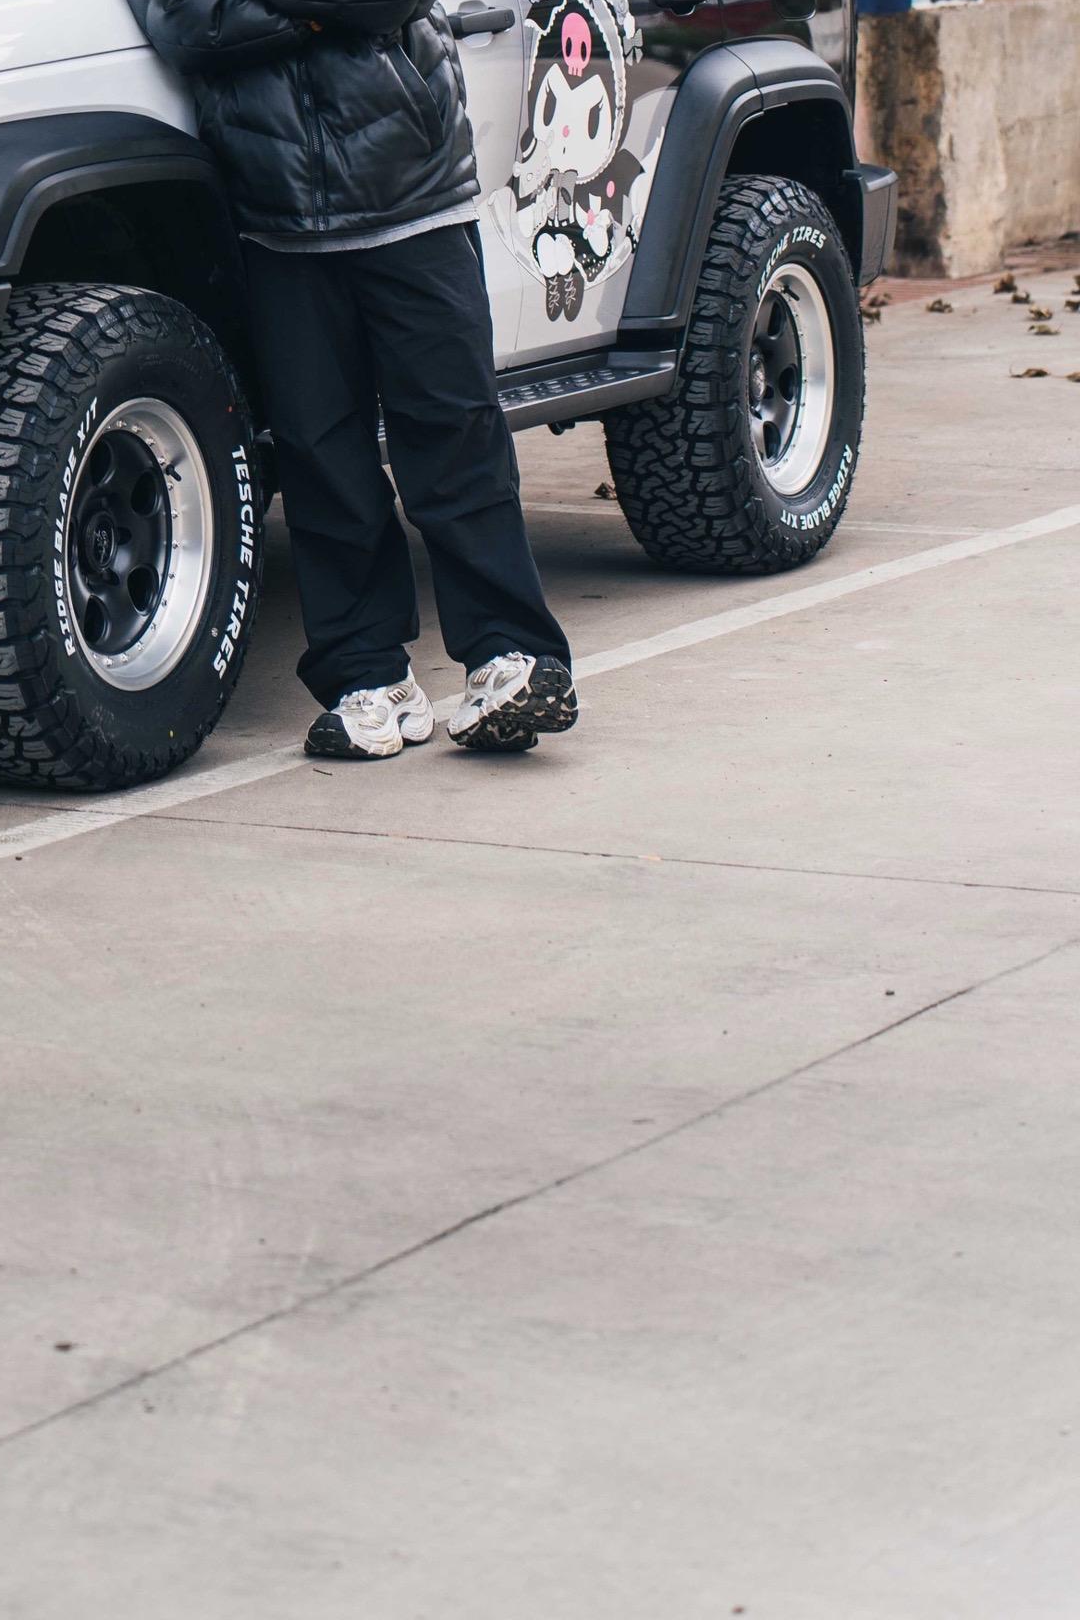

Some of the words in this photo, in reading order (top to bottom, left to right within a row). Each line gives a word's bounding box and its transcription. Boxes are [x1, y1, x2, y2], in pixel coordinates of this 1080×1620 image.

[792, 225, 827, 249] TIRES
[54, 446, 77, 553] BLADE
[231, 444, 254, 570] TESCHE
[799, 499, 831, 530] BLADE
[827, 444, 853, 509] RIDGE
[54, 558, 76, 657] RIDGE
[213, 579, 250, 680] TIRES
